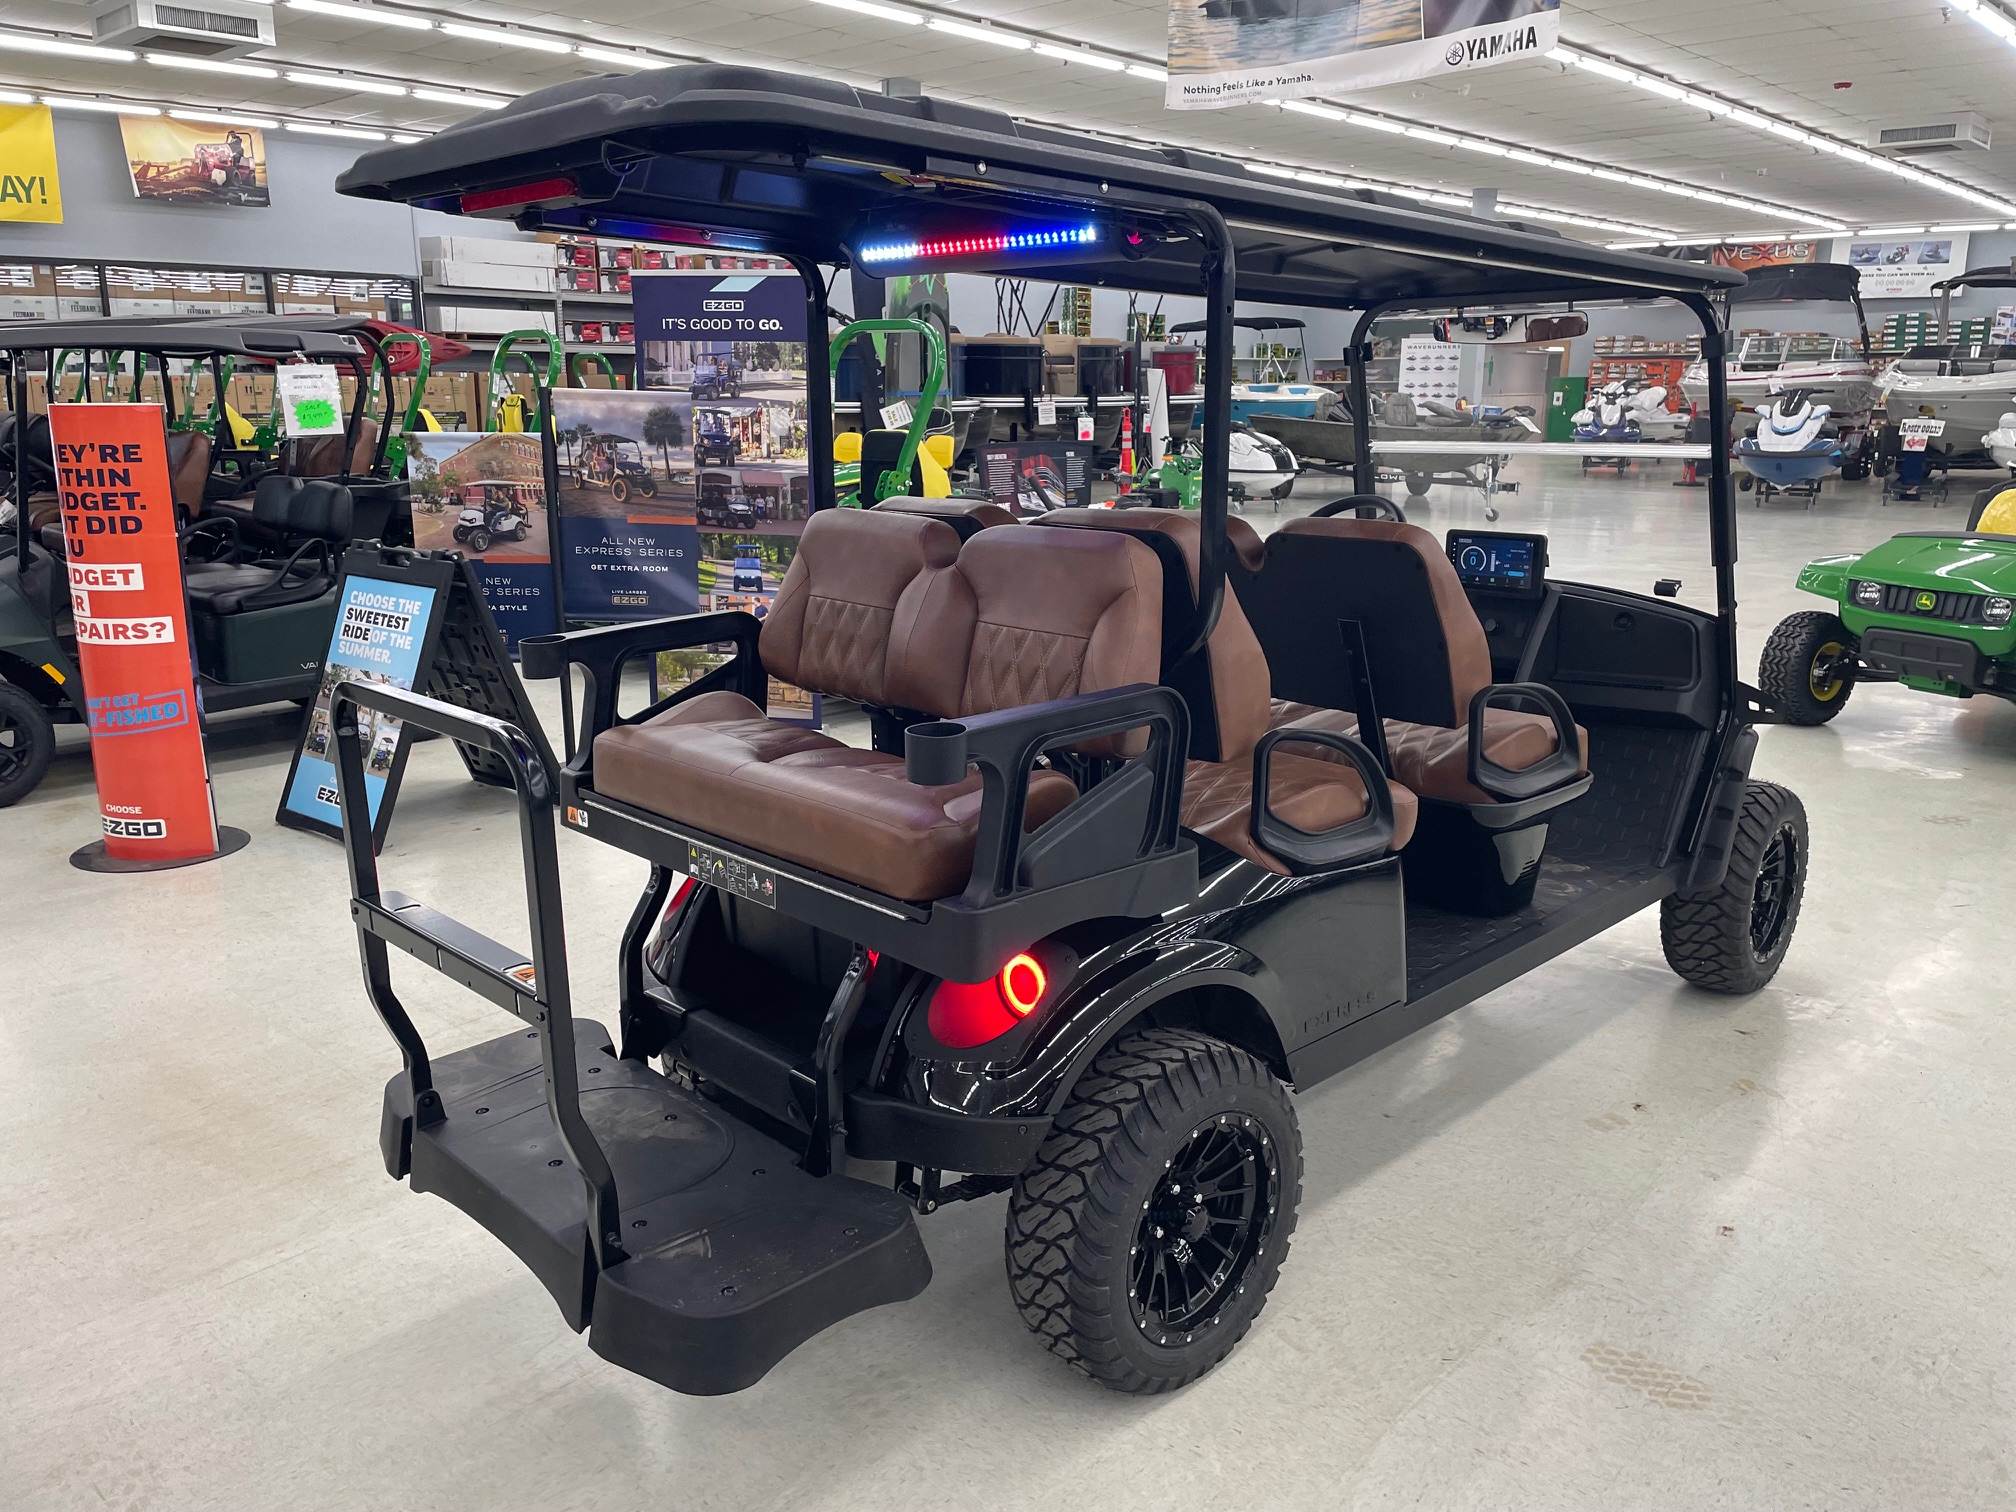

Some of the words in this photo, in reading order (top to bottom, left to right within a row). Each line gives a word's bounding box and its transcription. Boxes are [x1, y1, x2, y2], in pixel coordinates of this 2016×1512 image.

[1466, 26, 1538, 61] YAMAHA
[1183, 85, 1221, 95] Nothing
[1222, 82, 1243, 91] Feels
[1246, 79, 1266, 88] Like
[1276, 73, 1314, 85] Yamaha.
[0, 175, 47, 204] AY!
[1722, 244, 1809, 262] VEXUS
[704, 301, 743, 310] EZGO
[662, 318, 687, 330] IT'S
[690, 319, 732, 330] GOOD
[735, 319, 755, 330] TO
[759, 319, 783, 331] GO.
[56, 442, 142, 463] EY'RE
[85, 516, 142, 534] DID
[601, 537, 624, 545] ALL
[628, 537, 656, 546] NEW
[639, 548, 684, 558] SERIES
[485, 577, 511, 585] NEW
[496, 588, 540, 596] SERIES
[613, 596, 647, 604] EZGO
[350, 590, 397, 610] CHOOSE
[398, 599, 422, 615] THE
[346, 607, 409, 630] SWEETEST
[342, 624, 371, 641] RIDE
[371, 630, 388, 644] OF
[389, 633, 414, 650] THE
[338, 641, 392, 664] SUMMER.
[113, 693, 139, 708] GET
[106, 804, 142, 814] CHOOSE
[102, 817, 162, 836] EZGO
